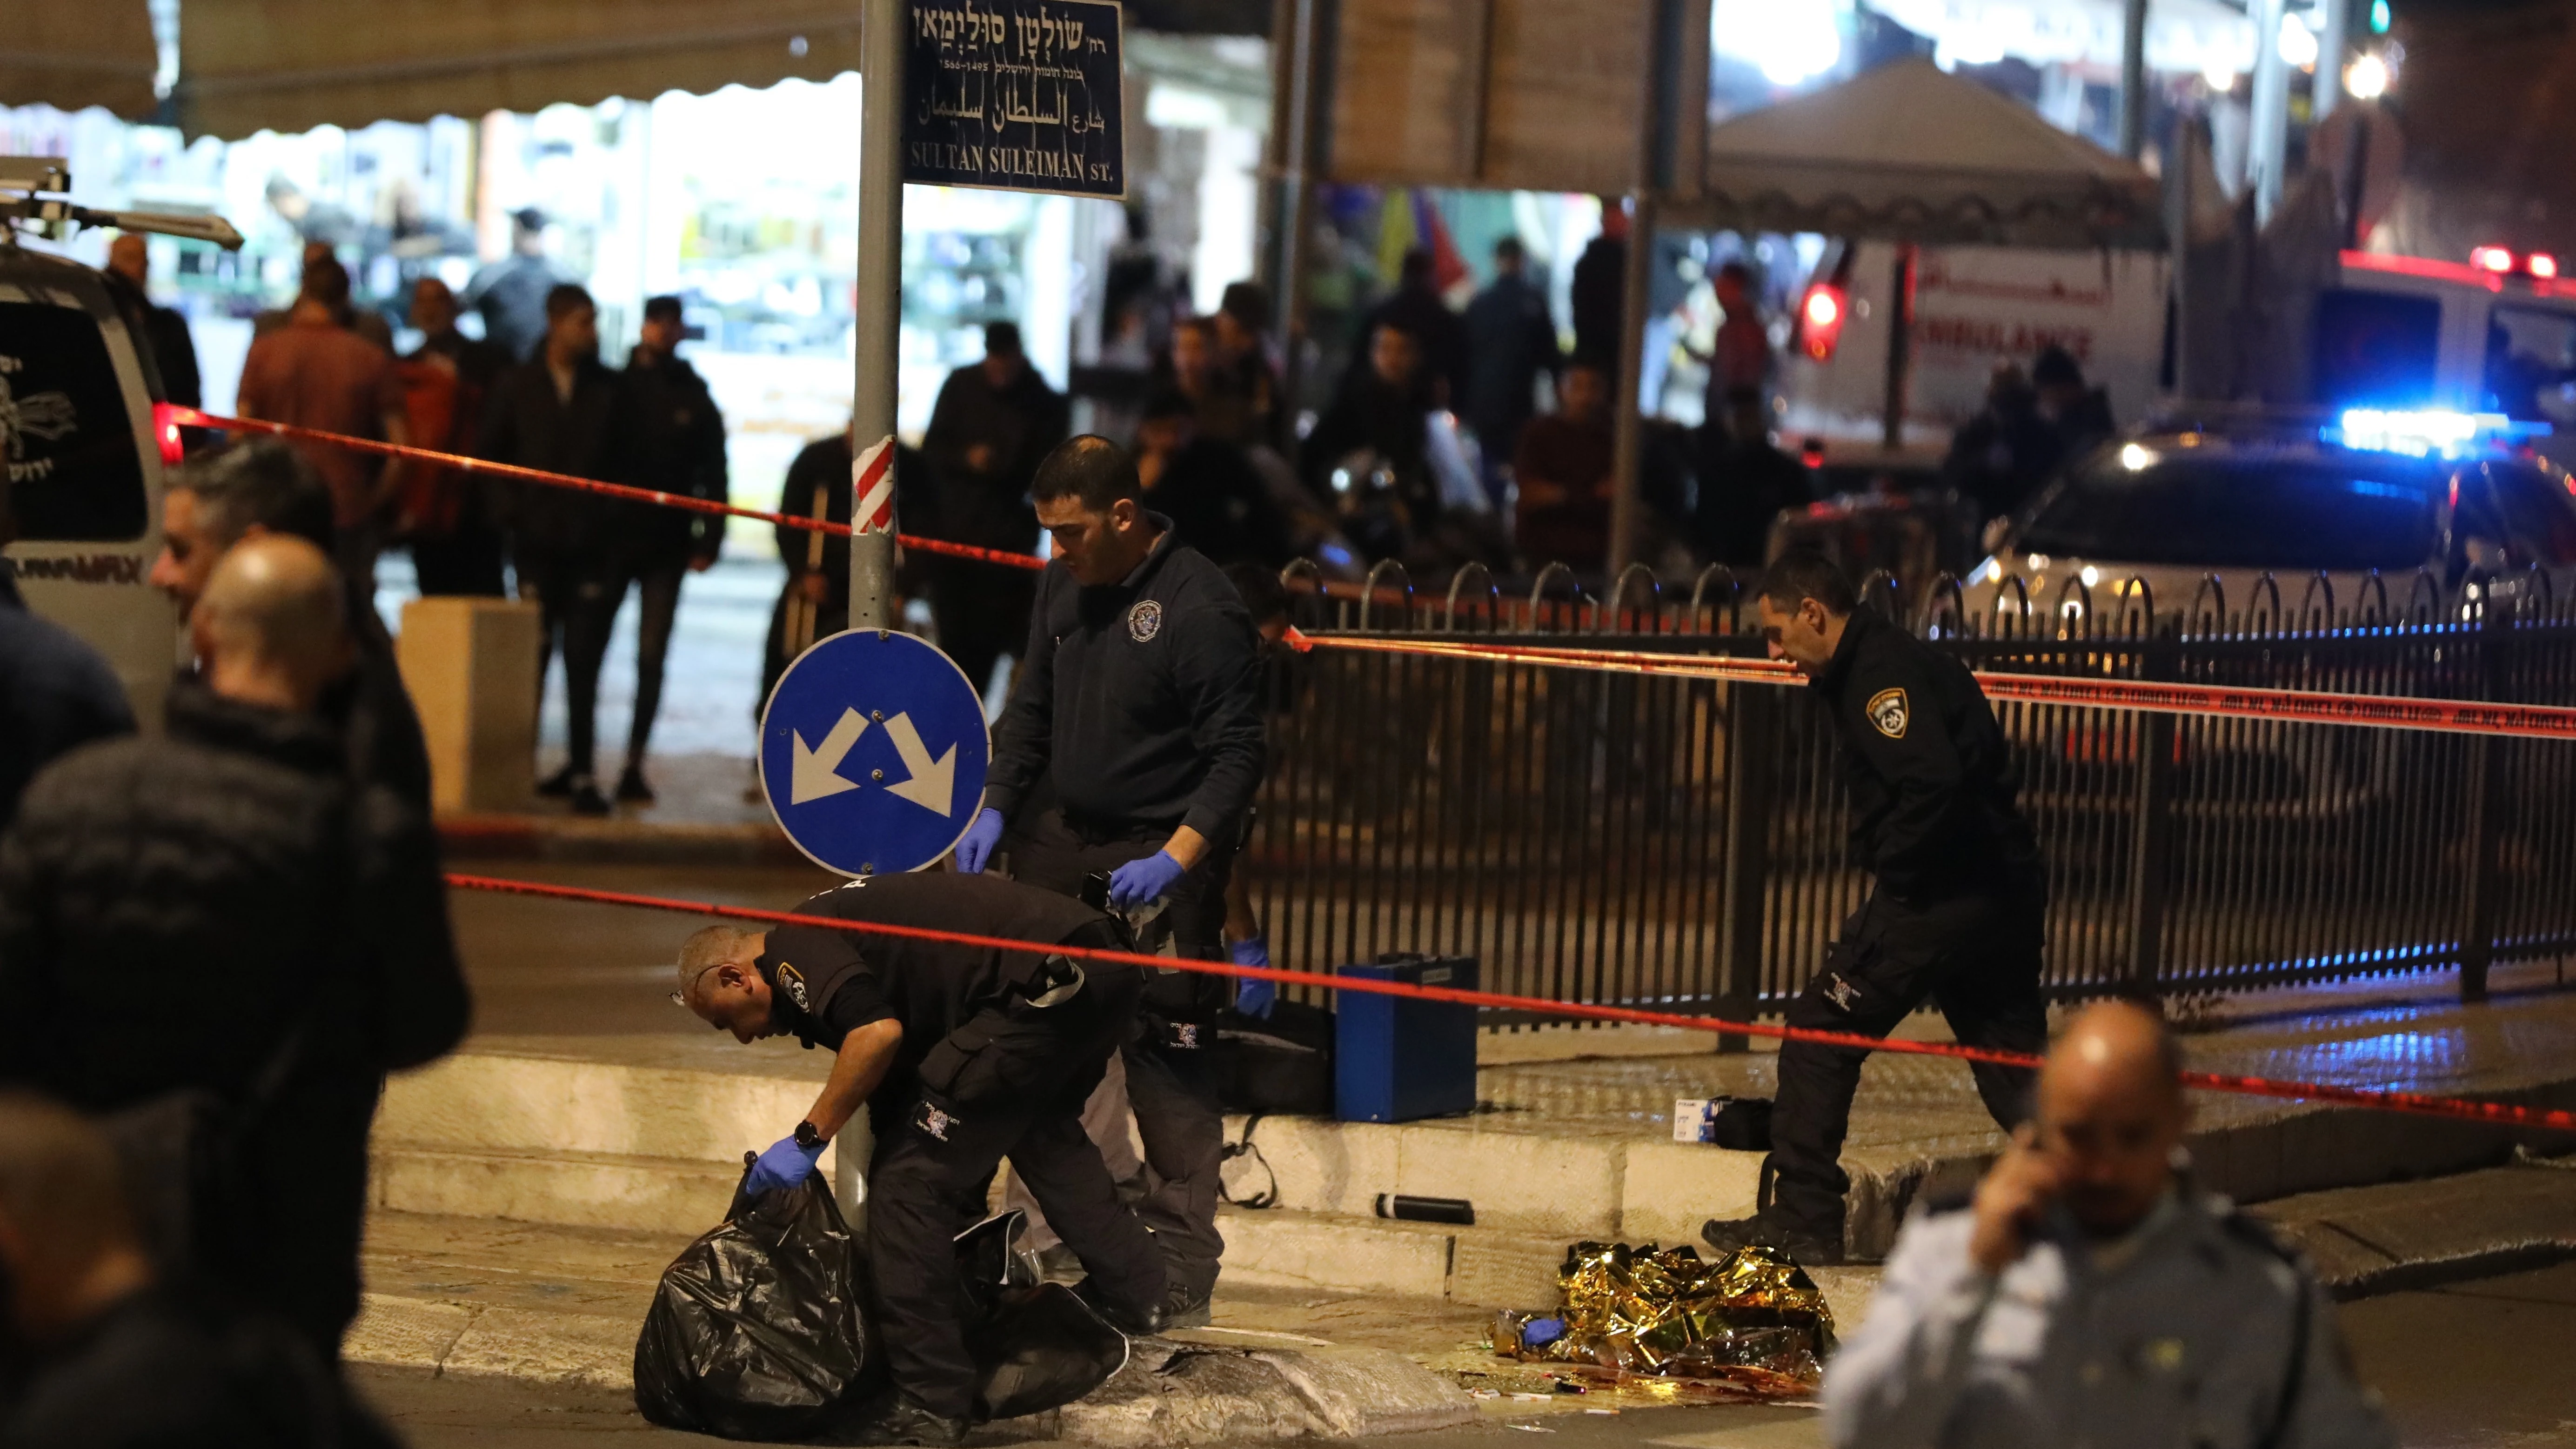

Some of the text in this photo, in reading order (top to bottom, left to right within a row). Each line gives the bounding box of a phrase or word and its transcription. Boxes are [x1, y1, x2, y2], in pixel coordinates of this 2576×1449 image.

[995, 63, 1030, 74] ירושלים
[1063, 68, 1084, 80] בונה
[918, 87, 1105, 134] شارع السلطان سليمان
[911, 141, 1114, 182] SULTAN SULEIMAN ST.
